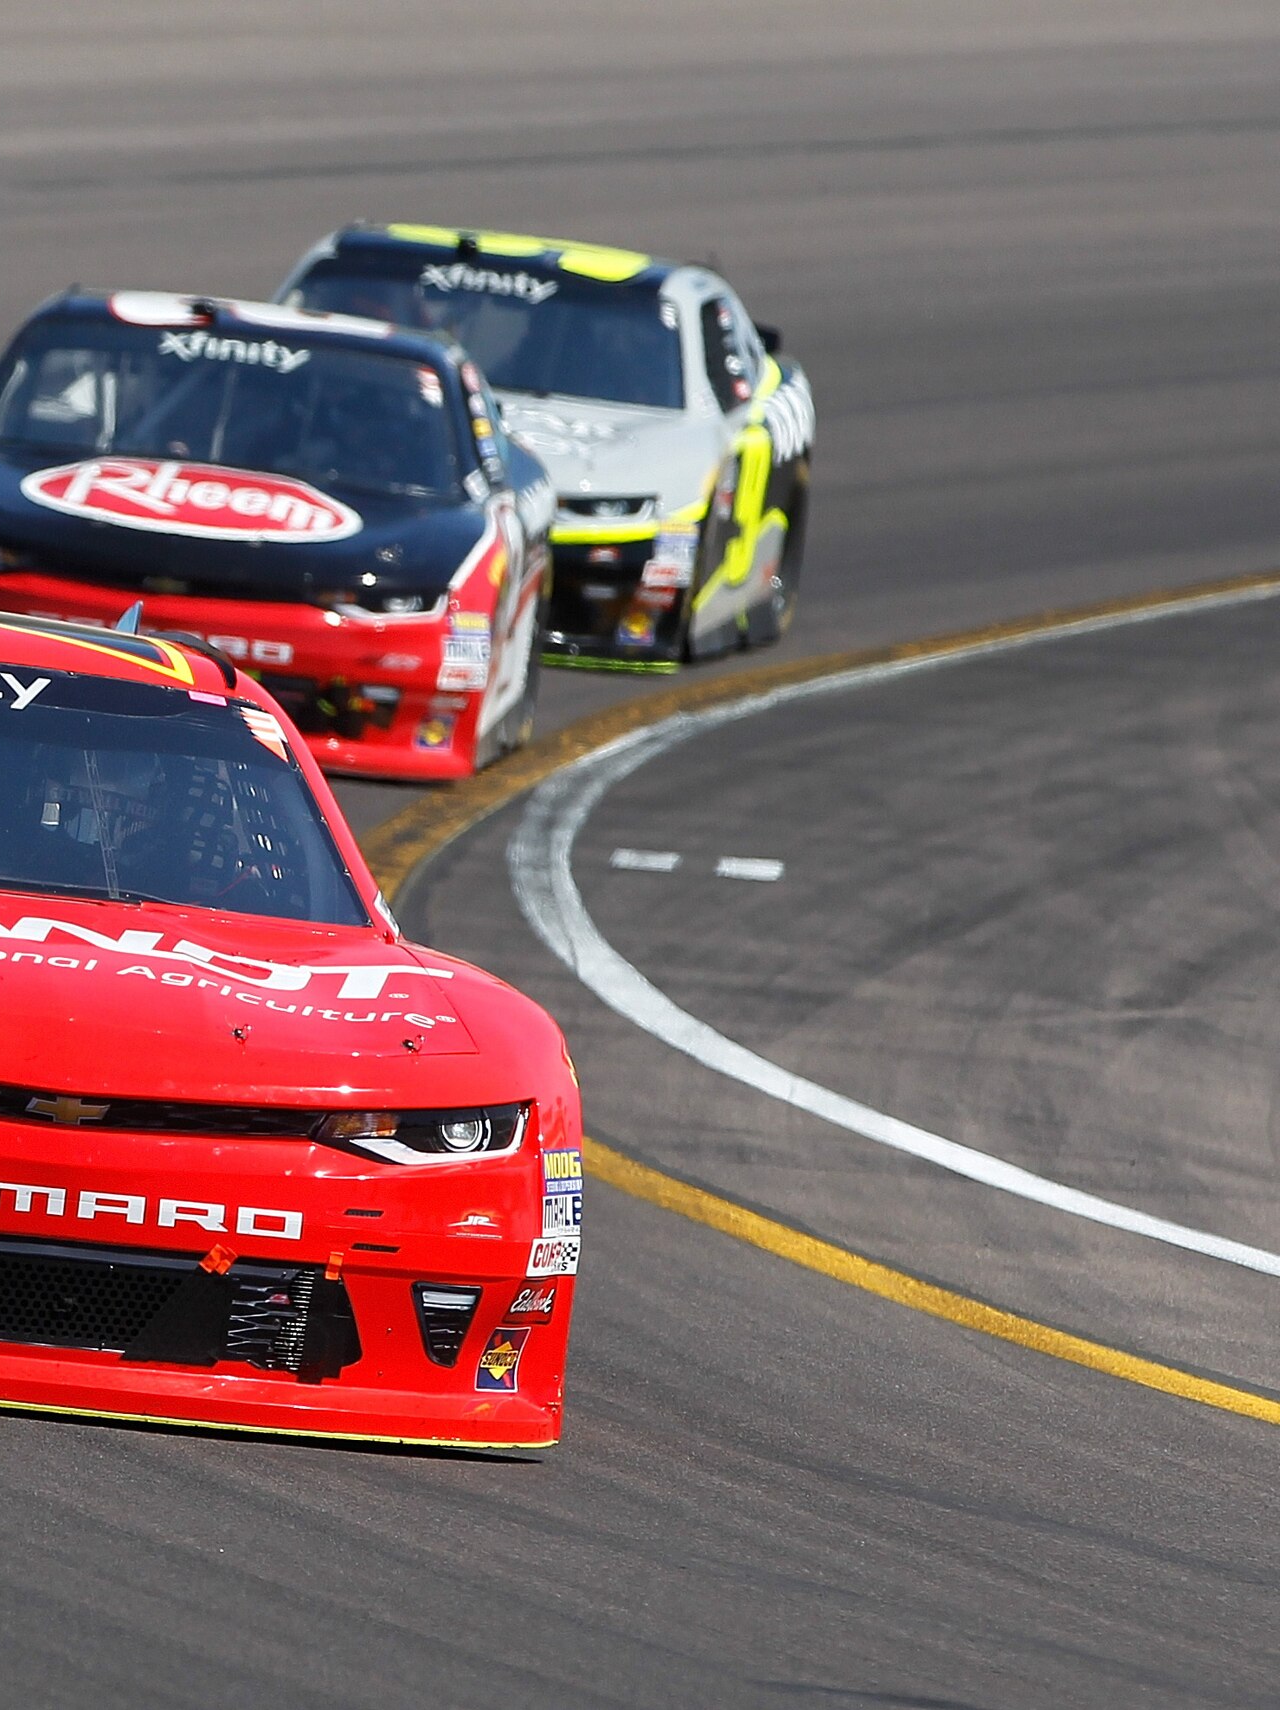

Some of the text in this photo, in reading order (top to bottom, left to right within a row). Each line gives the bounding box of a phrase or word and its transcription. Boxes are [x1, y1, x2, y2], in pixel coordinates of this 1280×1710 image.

[420, 263, 558, 304] xfinity
[158, 330, 311, 374] xfinity
[62, 461, 336, 530] Rheem
[544, 1151, 582, 1179] MOOG
